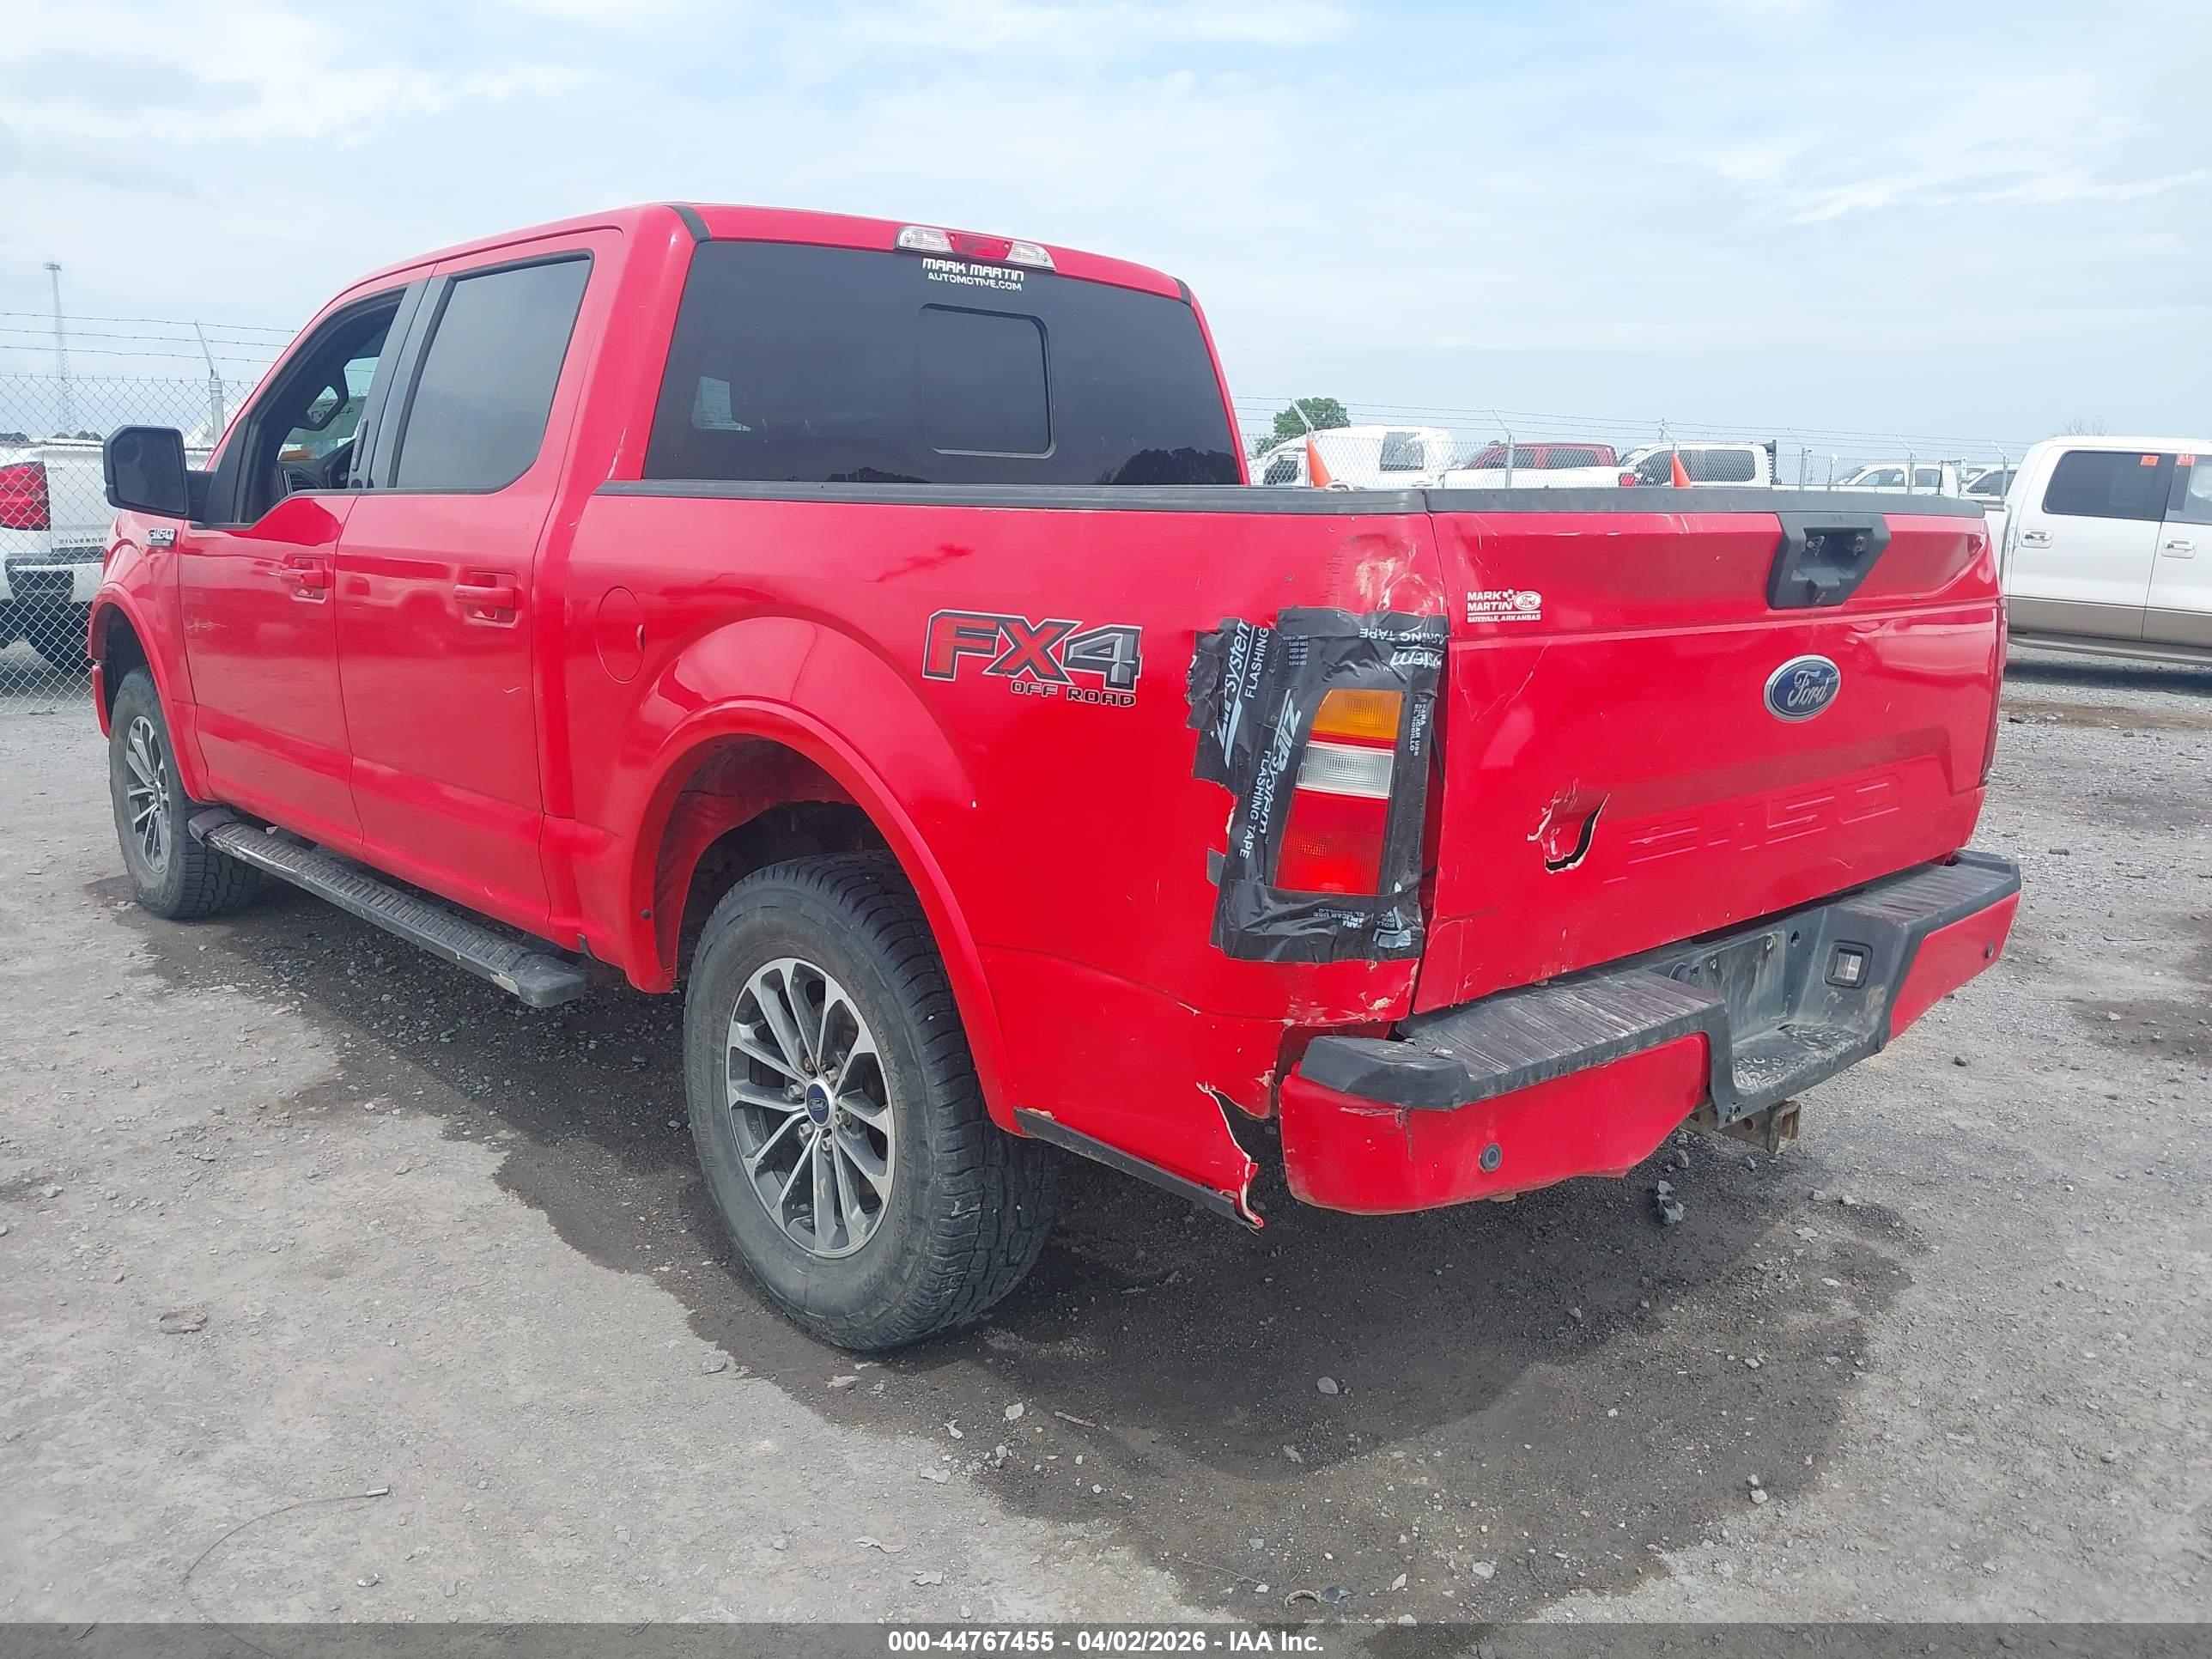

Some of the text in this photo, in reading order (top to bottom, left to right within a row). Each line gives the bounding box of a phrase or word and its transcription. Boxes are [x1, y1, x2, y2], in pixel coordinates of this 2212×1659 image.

[921, 258, 1024, 282] MARK MARTIN
[927, 271, 1022, 292] AUTOMOTIVE.COM
[1467, 591, 1502, 601] MARK
[1467, 601, 1513, 611] MARTIN
[1359, 628, 1395, 641] TAPE
[921, 609, 1143, 693] FX4
[1244, 628, 1269, 698] FLASHING
[1011, 681, 1136, 708] OFF ROAD
[1787, 670, 1834, 707] Ford
[1239, 750, 1272, 860] FLASHING TAPE
